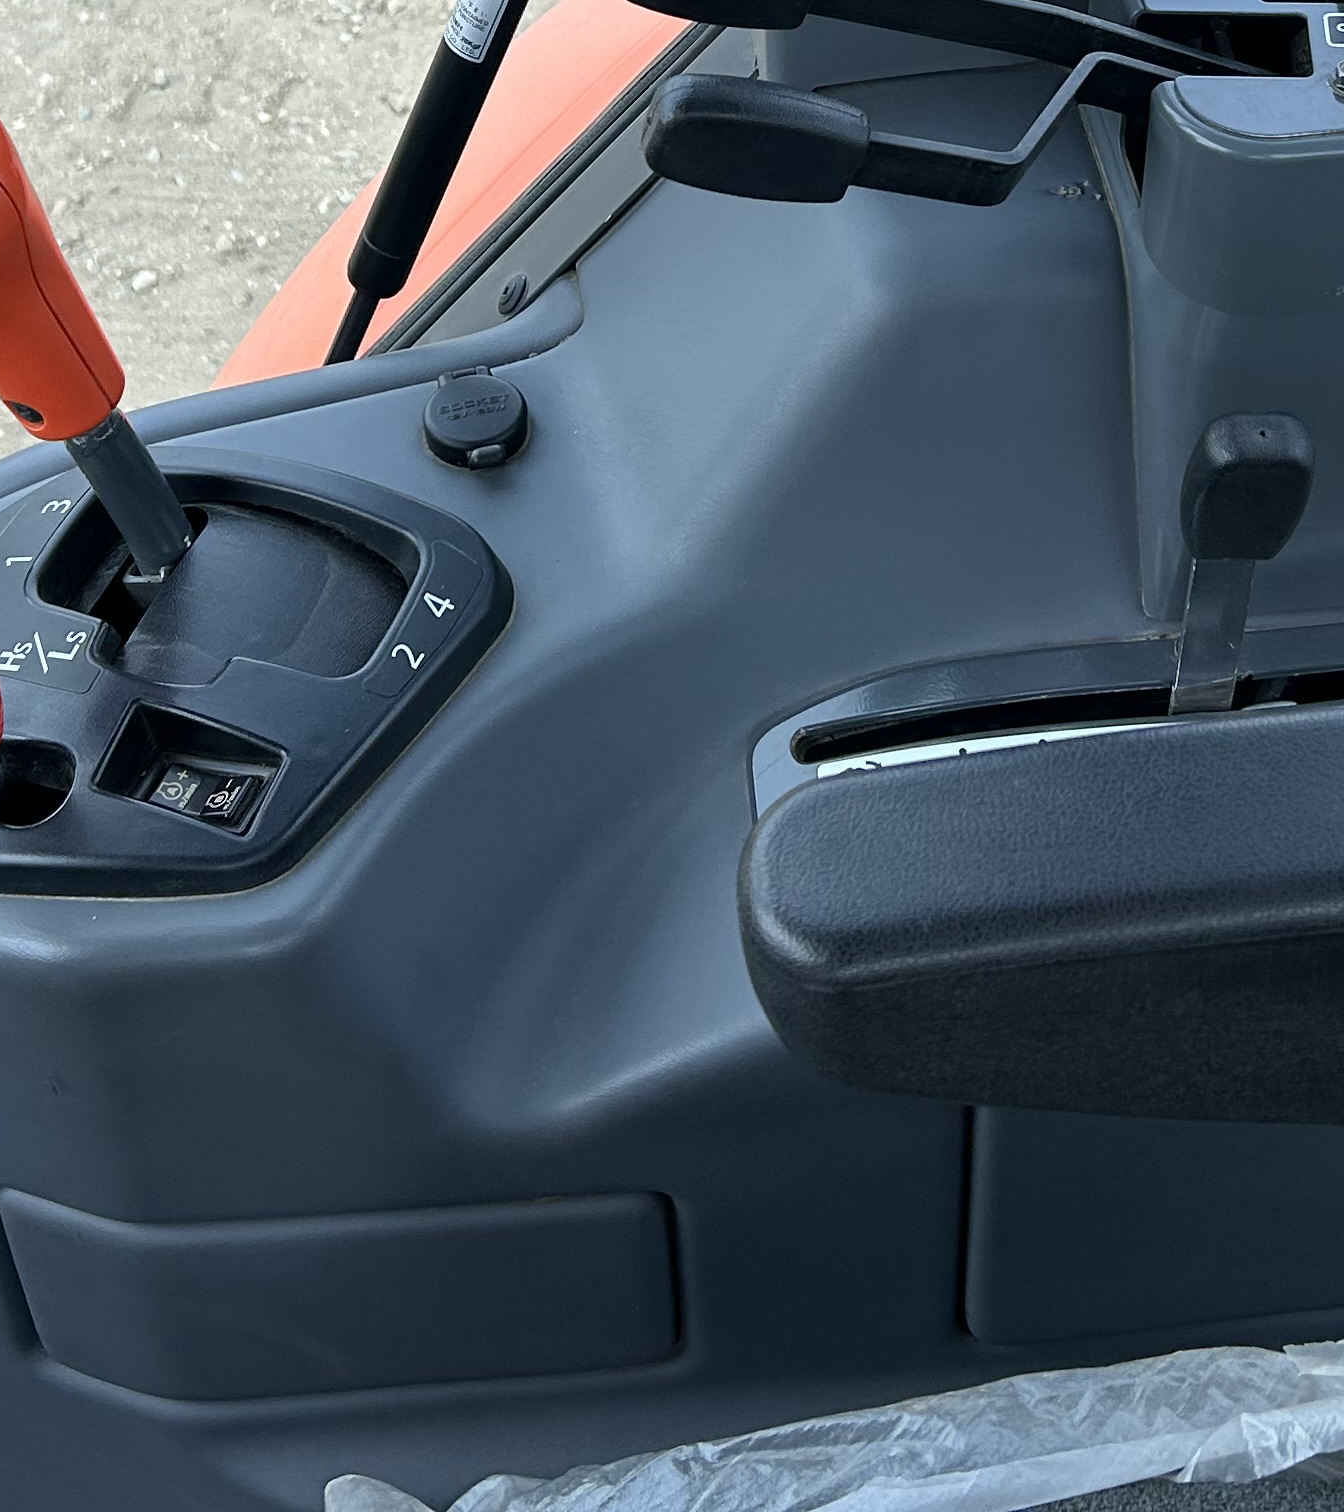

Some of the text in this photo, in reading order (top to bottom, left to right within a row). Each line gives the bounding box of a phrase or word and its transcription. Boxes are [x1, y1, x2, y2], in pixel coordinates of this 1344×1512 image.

[41, 499, 72, 514] 3
[5, 556, 34, 567] 1
[422, 592, 456, 618] 4
[391, 643, 426, 670] 2
